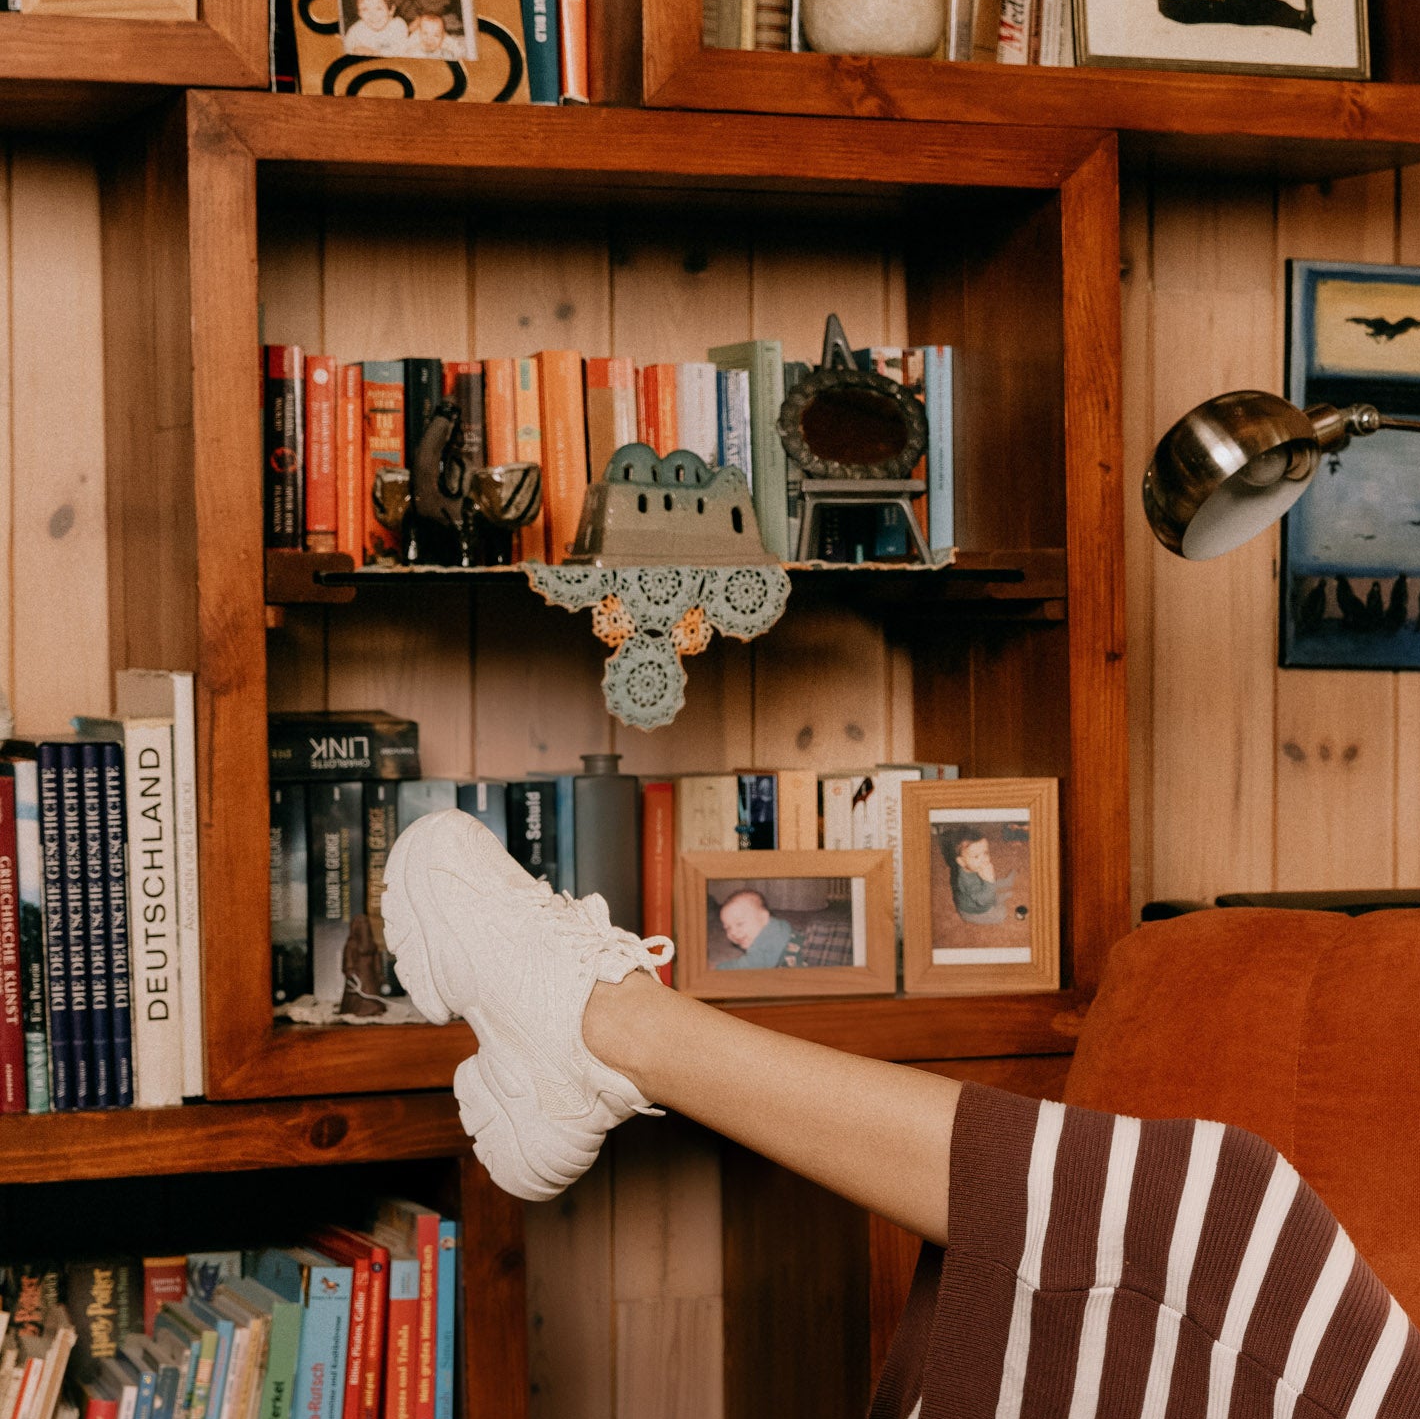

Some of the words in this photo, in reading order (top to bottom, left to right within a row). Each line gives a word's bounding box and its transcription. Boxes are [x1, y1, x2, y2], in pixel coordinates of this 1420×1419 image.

[534, 15, 548, 42] BILD
[309, 736, 369, 759] LINK
[42, 767, 61, 880] GESCHICHTE
[63, 767, 82, 879] GESCHICHTE
[84, 767, 102, 878] GESCHICHTE
[105, 766, 123, 877] GESCHICHTE
[525, 791, 542, 840] Schuld
[325, 832, 340, 869] GEORGE
[139, 747, 169, 1021] DEUTSCHLAND
[326, 870, 341, 918] ELIZABETH
[46, 882, 65, 975] DEUTSCHE
[67, 882, 85, 974] DEUTSCHE
[88, 881, 105, 974] DEUTSCHE
[109, 880, 127, 973] DEUTSCHE
[3, 970, 19, 1026] KUNST
[51, 979, 66, 1011] DIE
[72, 979, 87, 1010] DIE
[91, 978, 107, 1009] DIE
[113, 977, 130, 1008] DIE
[86, 1268, 116, 1317] Potter
